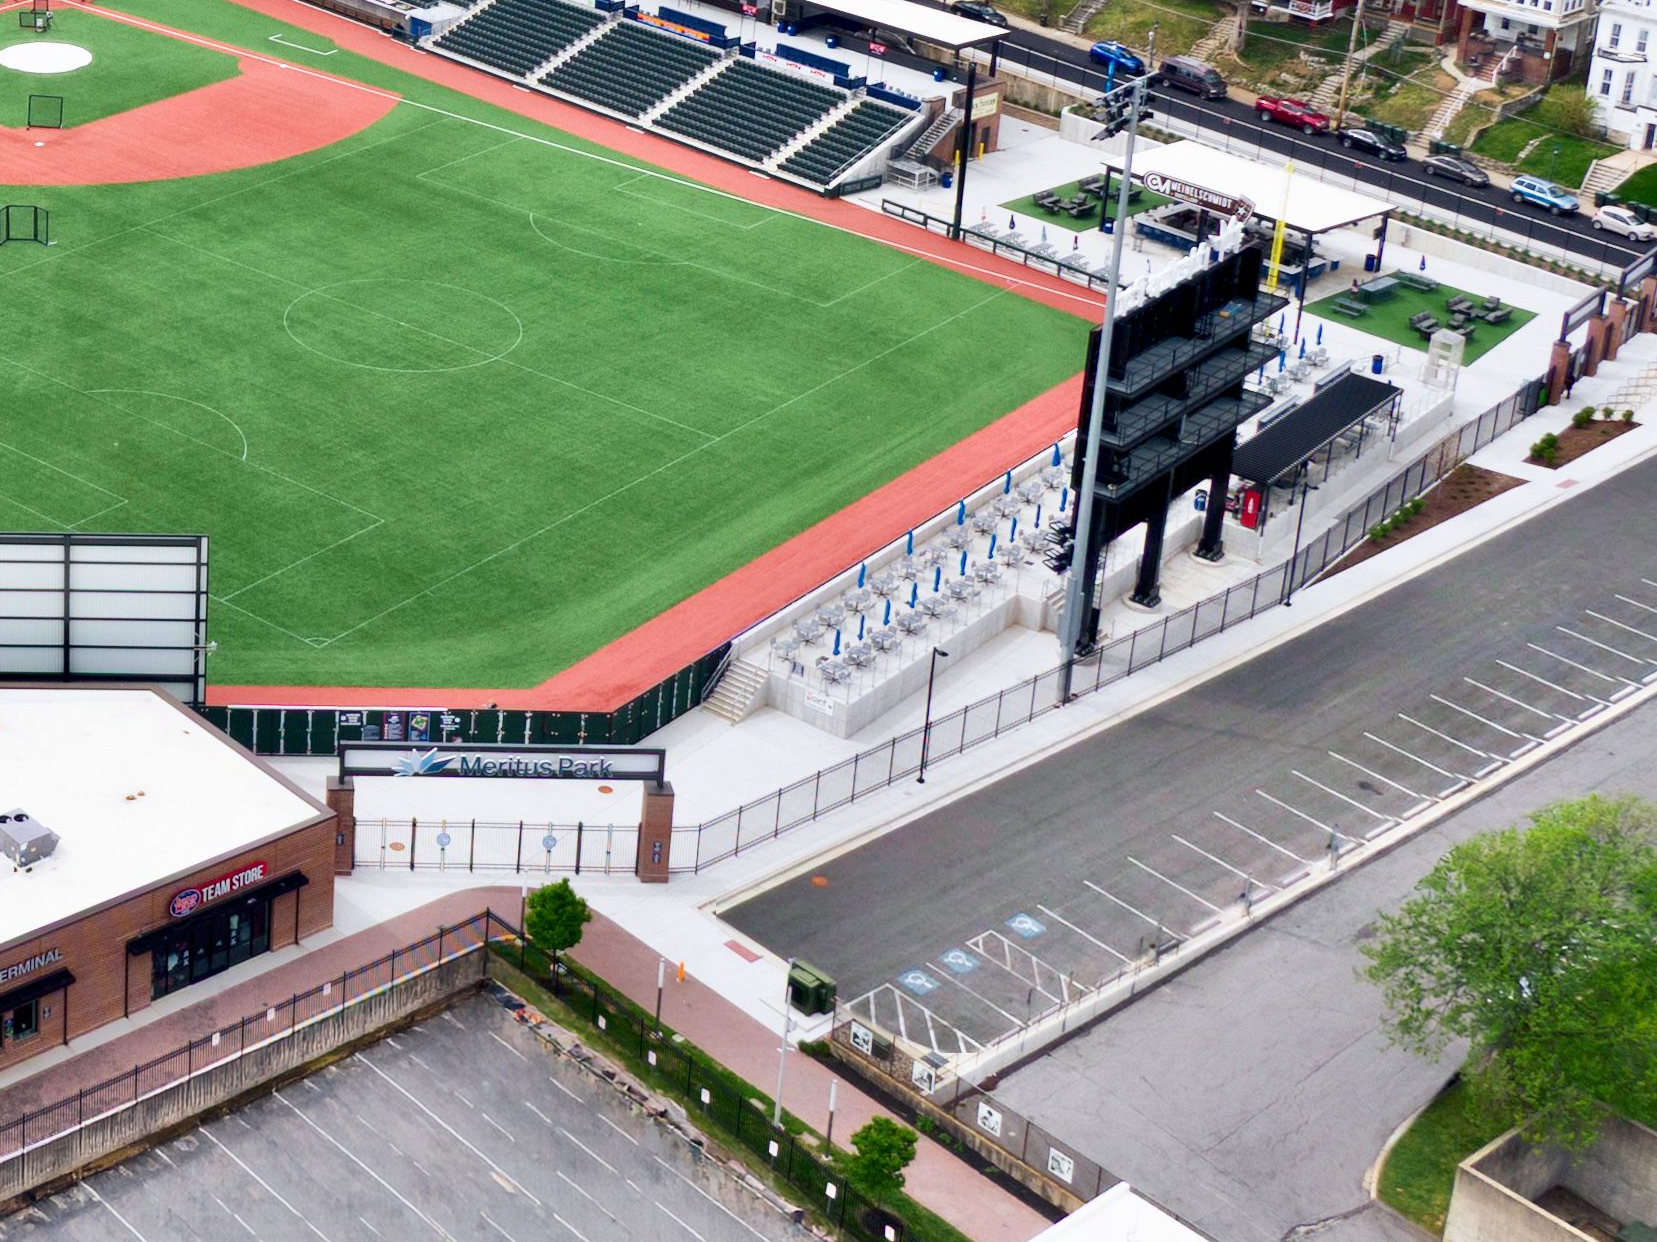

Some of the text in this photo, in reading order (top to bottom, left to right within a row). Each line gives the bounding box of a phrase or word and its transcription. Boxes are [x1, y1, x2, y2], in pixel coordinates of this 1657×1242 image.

[459, 754, 614, 778] Meritus Park
[202, 878, 230, 903] TEAM
[232, 864, 264, 890] STORE
